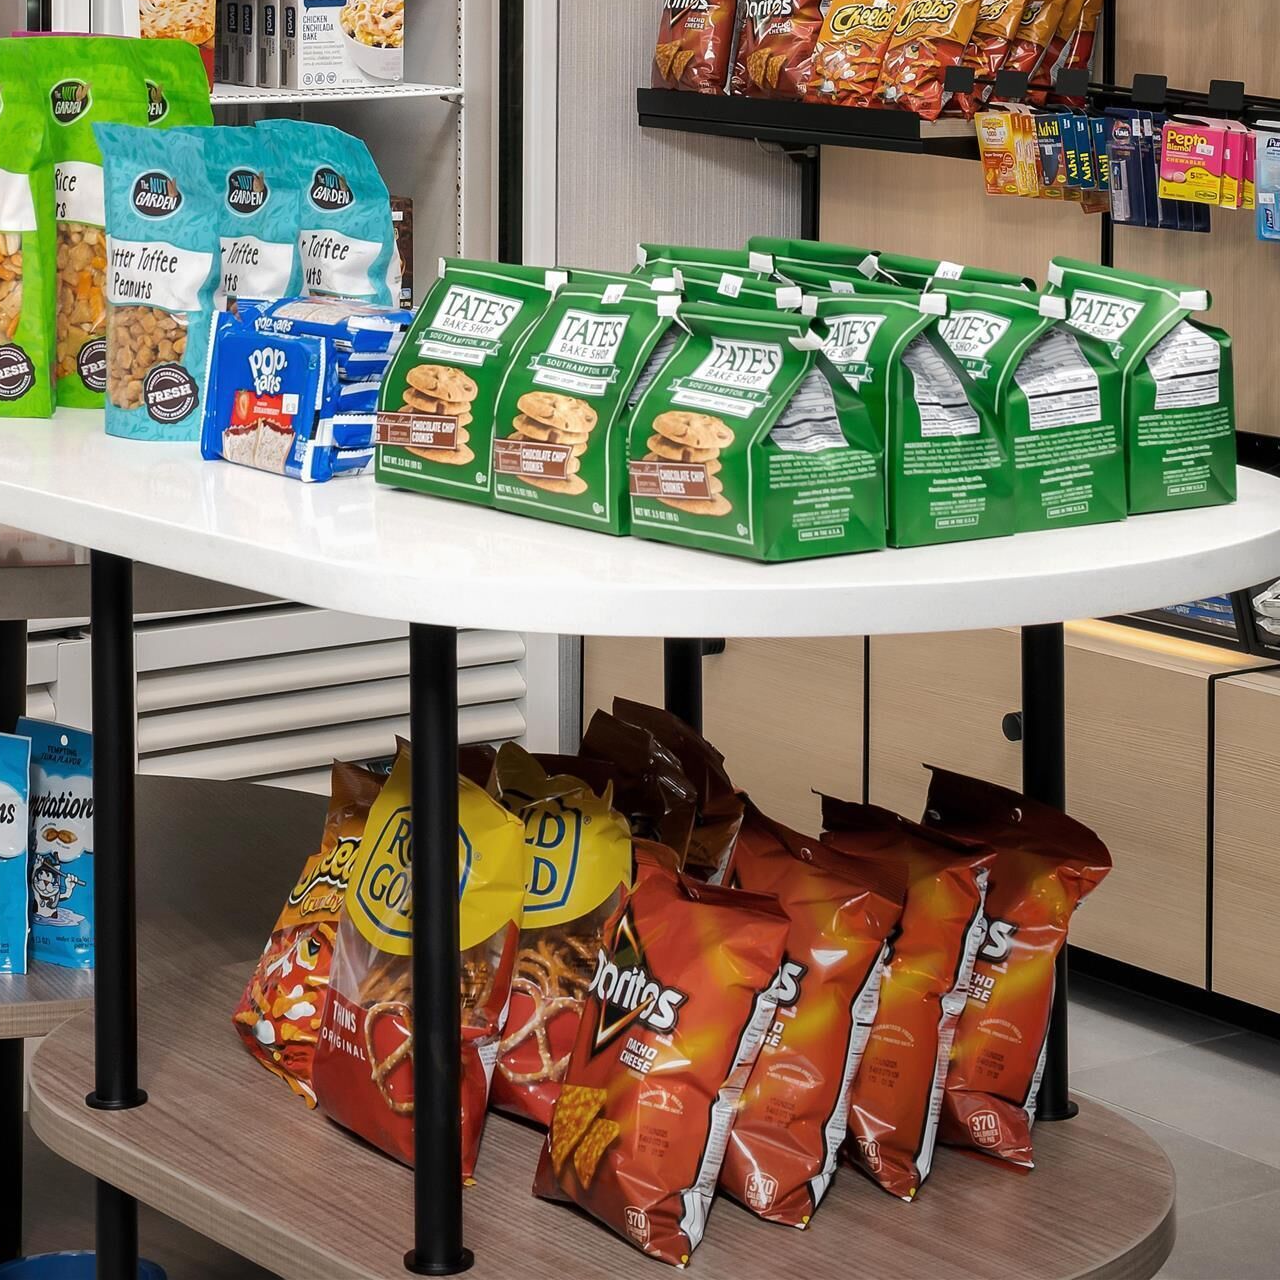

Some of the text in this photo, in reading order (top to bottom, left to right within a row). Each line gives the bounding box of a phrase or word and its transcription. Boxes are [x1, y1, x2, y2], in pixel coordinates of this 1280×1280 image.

[302, 15, 328, 24] CHICKEN
[302, 23, 334, 32] ENCHILADA
[302, 32, 318, 41] BAKE
[1167, 130, 1207, 146] Pepto
[1166, 143, 1192, 153] Bismol
[1166, 157, 1206, 167] CHEWABLES
[150, 177, 168, 195] NUT
[135, 190, 178, 211] GARDEN
[137, 251, 179, 274] Toffee
[113, 274, 153, 300] Peanuts
[444, 291, 515, 327] TATE'S
[442, 318, 495, 334] BAKE SHOP
[711, 343, 779, 376] TATE'S
[705, 369, 762, 386] BAKE SHOP
[147, 383, 193, 405] FRESH
[412, 421, 456, 433] CHOCOLATE CHIP
[412, 432, 434, 443] COOKIES
[333, 1000, 357, 1033] THINS
[322, 1026, 366, 1061] ORIGINAL
[626, 1037, 658, 1061] NACHO
[619, 1048, 652, 1074] CHEESE
